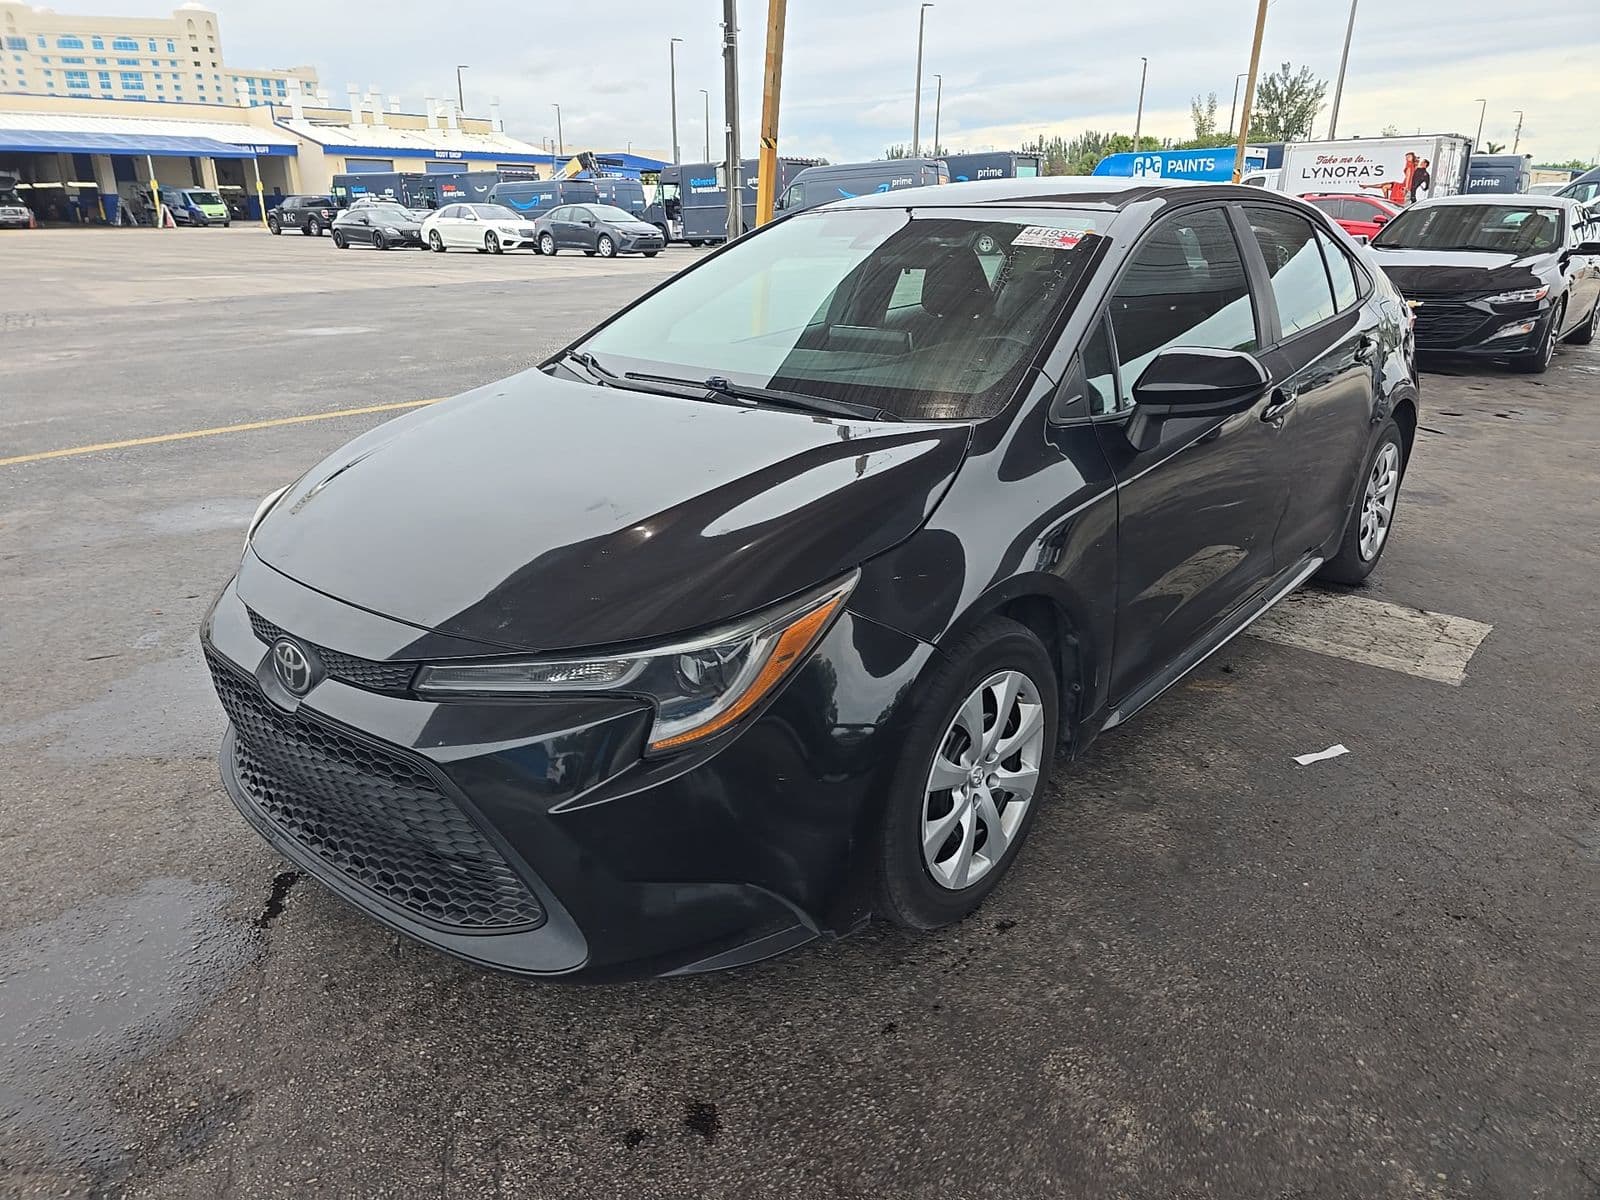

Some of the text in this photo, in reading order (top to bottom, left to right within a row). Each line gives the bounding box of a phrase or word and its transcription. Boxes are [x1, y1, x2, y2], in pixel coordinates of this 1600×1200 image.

[1167, 158, 1215, 173] PAINTS
[1316, 155, 1338, 165] Take
[977, 167, 1003, 179] prime
[1302, 165, 1385, 179] LYNORA'S
[892, 177, 913, 187] prime
[1470, 177, 1500, 188] prime
